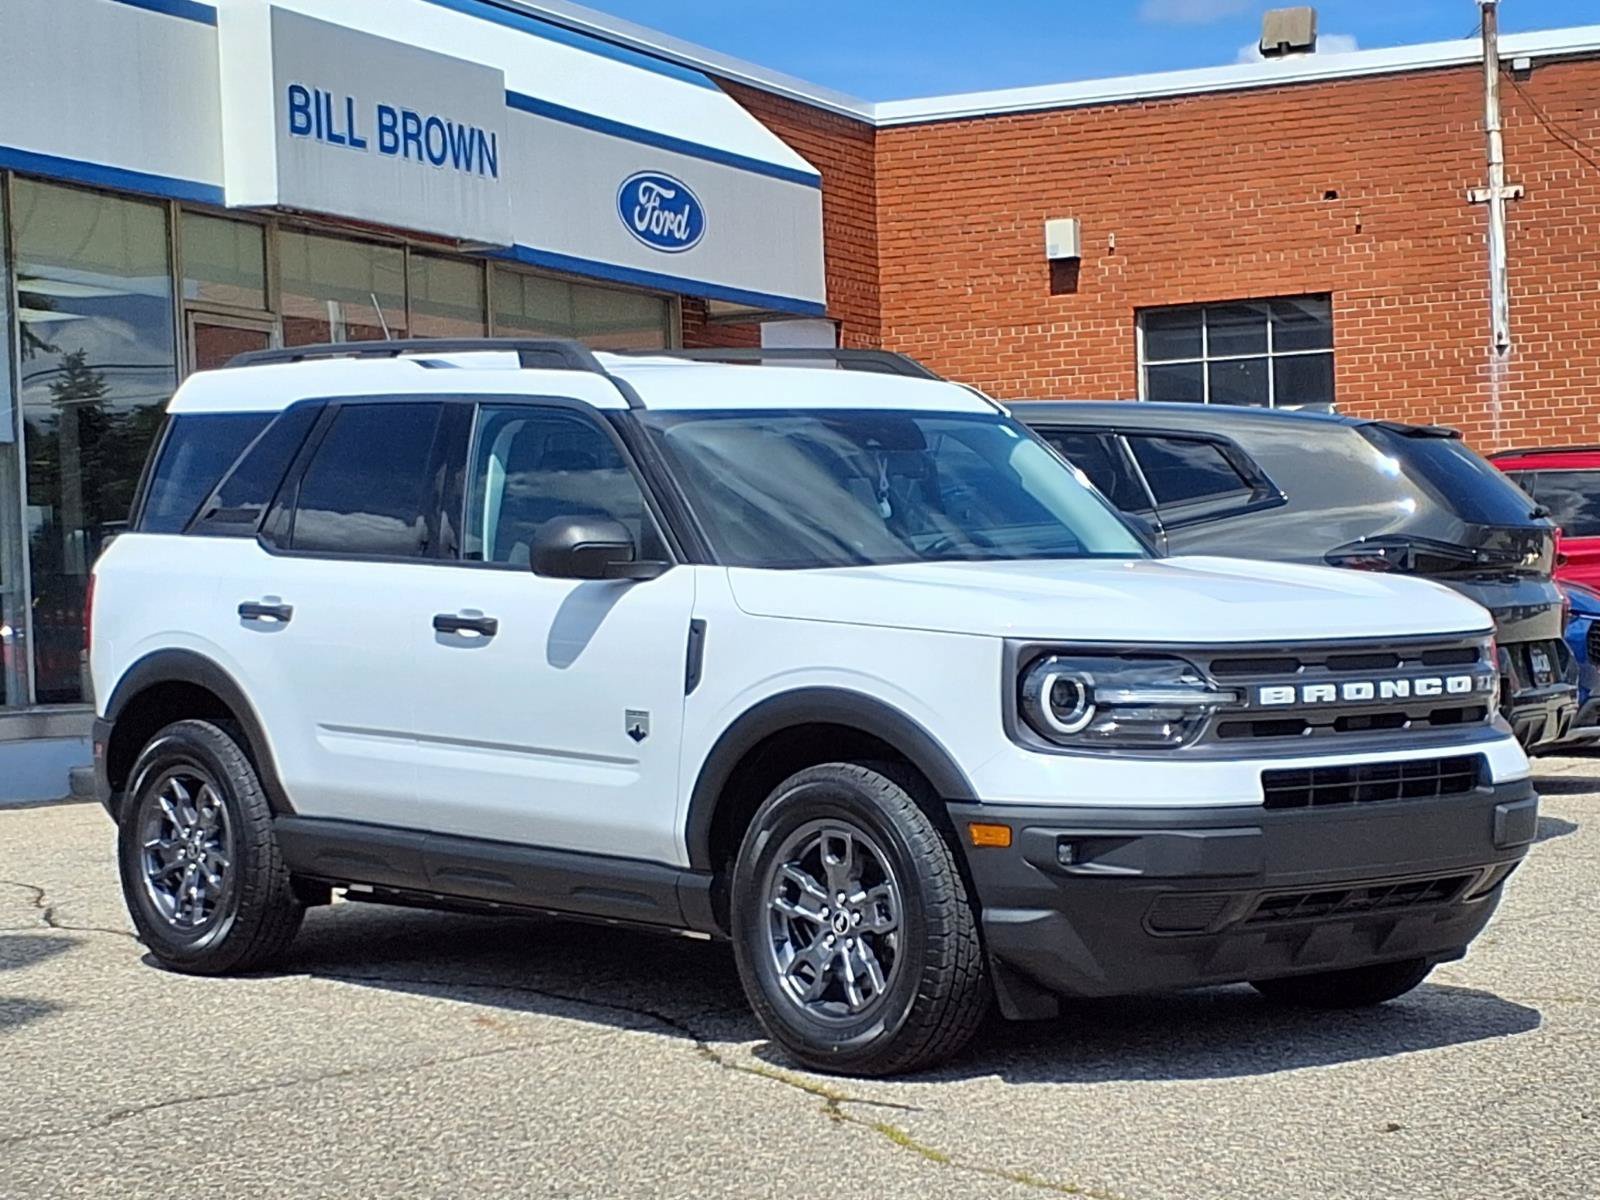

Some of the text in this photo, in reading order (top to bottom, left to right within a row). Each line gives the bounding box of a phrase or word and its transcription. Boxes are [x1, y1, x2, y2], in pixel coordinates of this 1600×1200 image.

[288, 84, 498, 179] BILL BROWN
[634, 181, 691, 240] Ford
[1259, 675, 1472, 706] BRONCO
